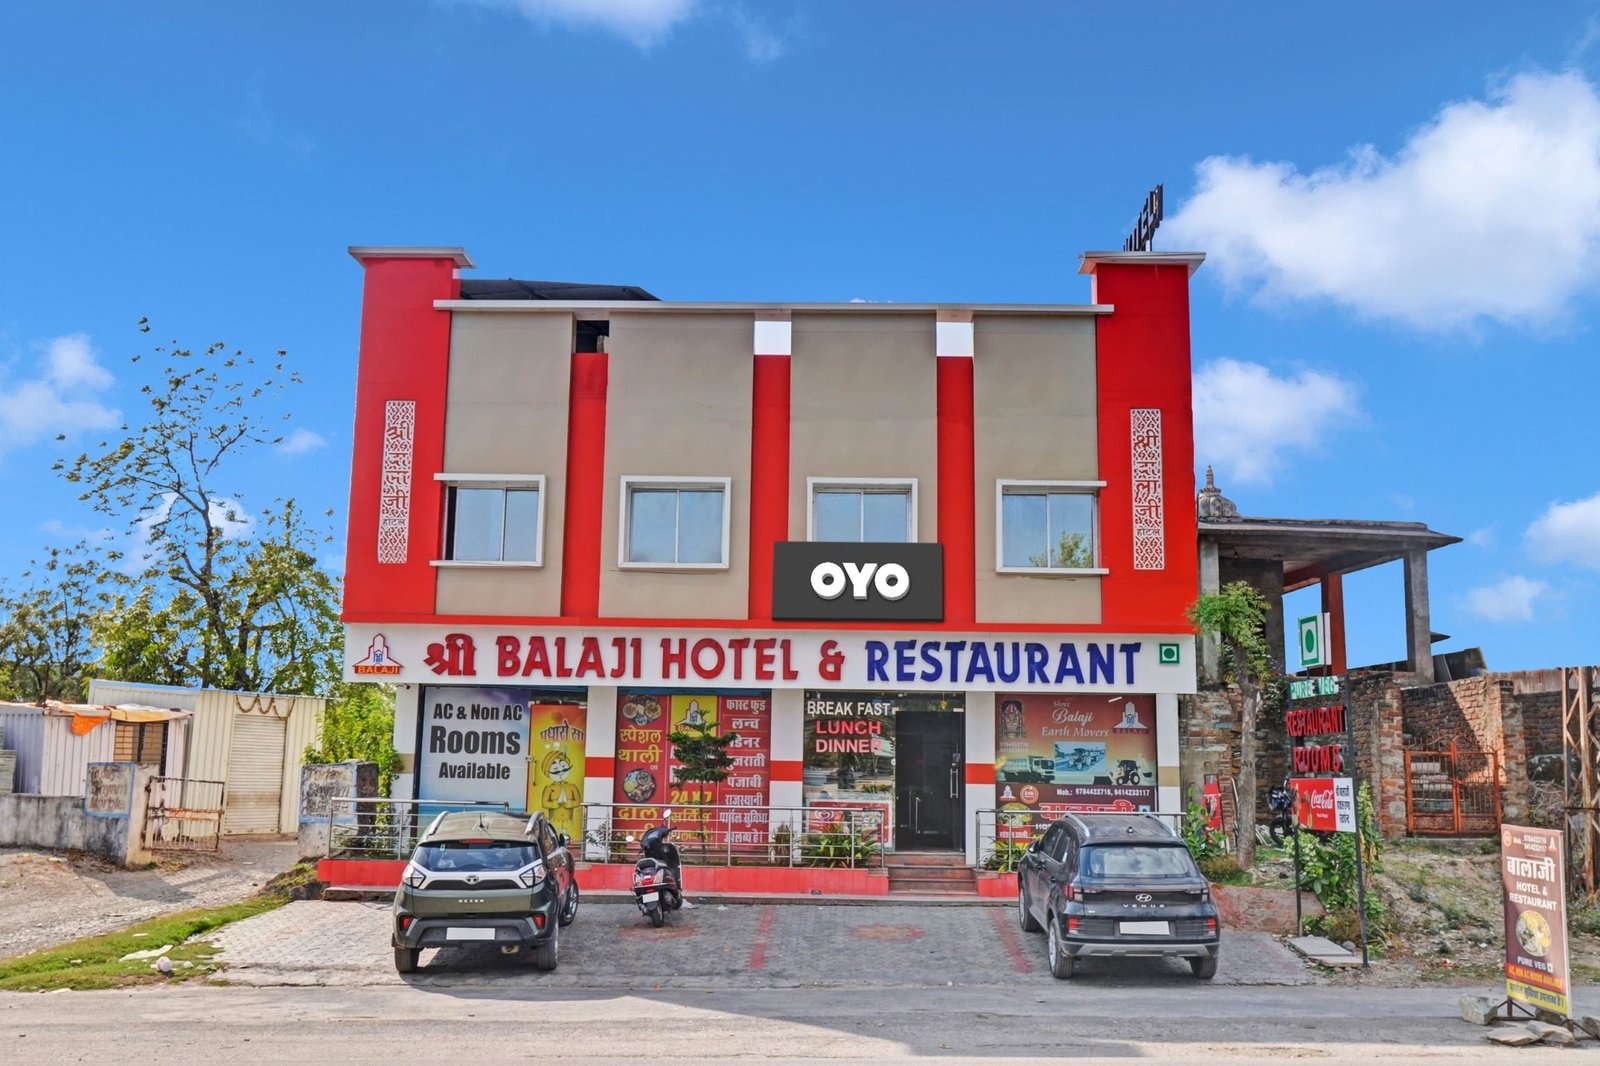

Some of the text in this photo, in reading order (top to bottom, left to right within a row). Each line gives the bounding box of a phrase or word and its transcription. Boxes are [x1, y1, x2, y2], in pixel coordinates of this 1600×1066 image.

[1137, 527, 1160, 536] होटल
[810, 561, 911, 600] OYO
[423, 633, 1142, 684] श्री BALAJI HOTEL & RESTAURANT
[357, 666, 398, 674] BALAJI
[1289, 676, 1338, 699] PURE VEG
[433, 703, 522, 720] AC & Non AC
[807, 701, 890, 716] BREAK FAST
[1052, 708, 1094, 726] Balaji
[731, 717, 761, 729] लन्च
[816, 720, 882, 735] LUNCH
[1286, 704, 1343, 736] RESTAURANT
[429, 725, 521, 755] Rooms
[619, 725, 663, 744] स्पेशल
[1041, 726, 1109, 737] Earth Movers
[618, 744, 663, 763] थाली
[816, 738, 883, 753] DINNER
[1293, 744, 1341, 773] ROOMS
[439, 762, 511, 780] Available
[1506, 856, 1556, 882] बालाजी
[1517, 881, 1549, 896] HOTEL &
[1509, 892, 1557, 911] RESTAURANT
[1517, 956, 1546, 971] PURE VEG
